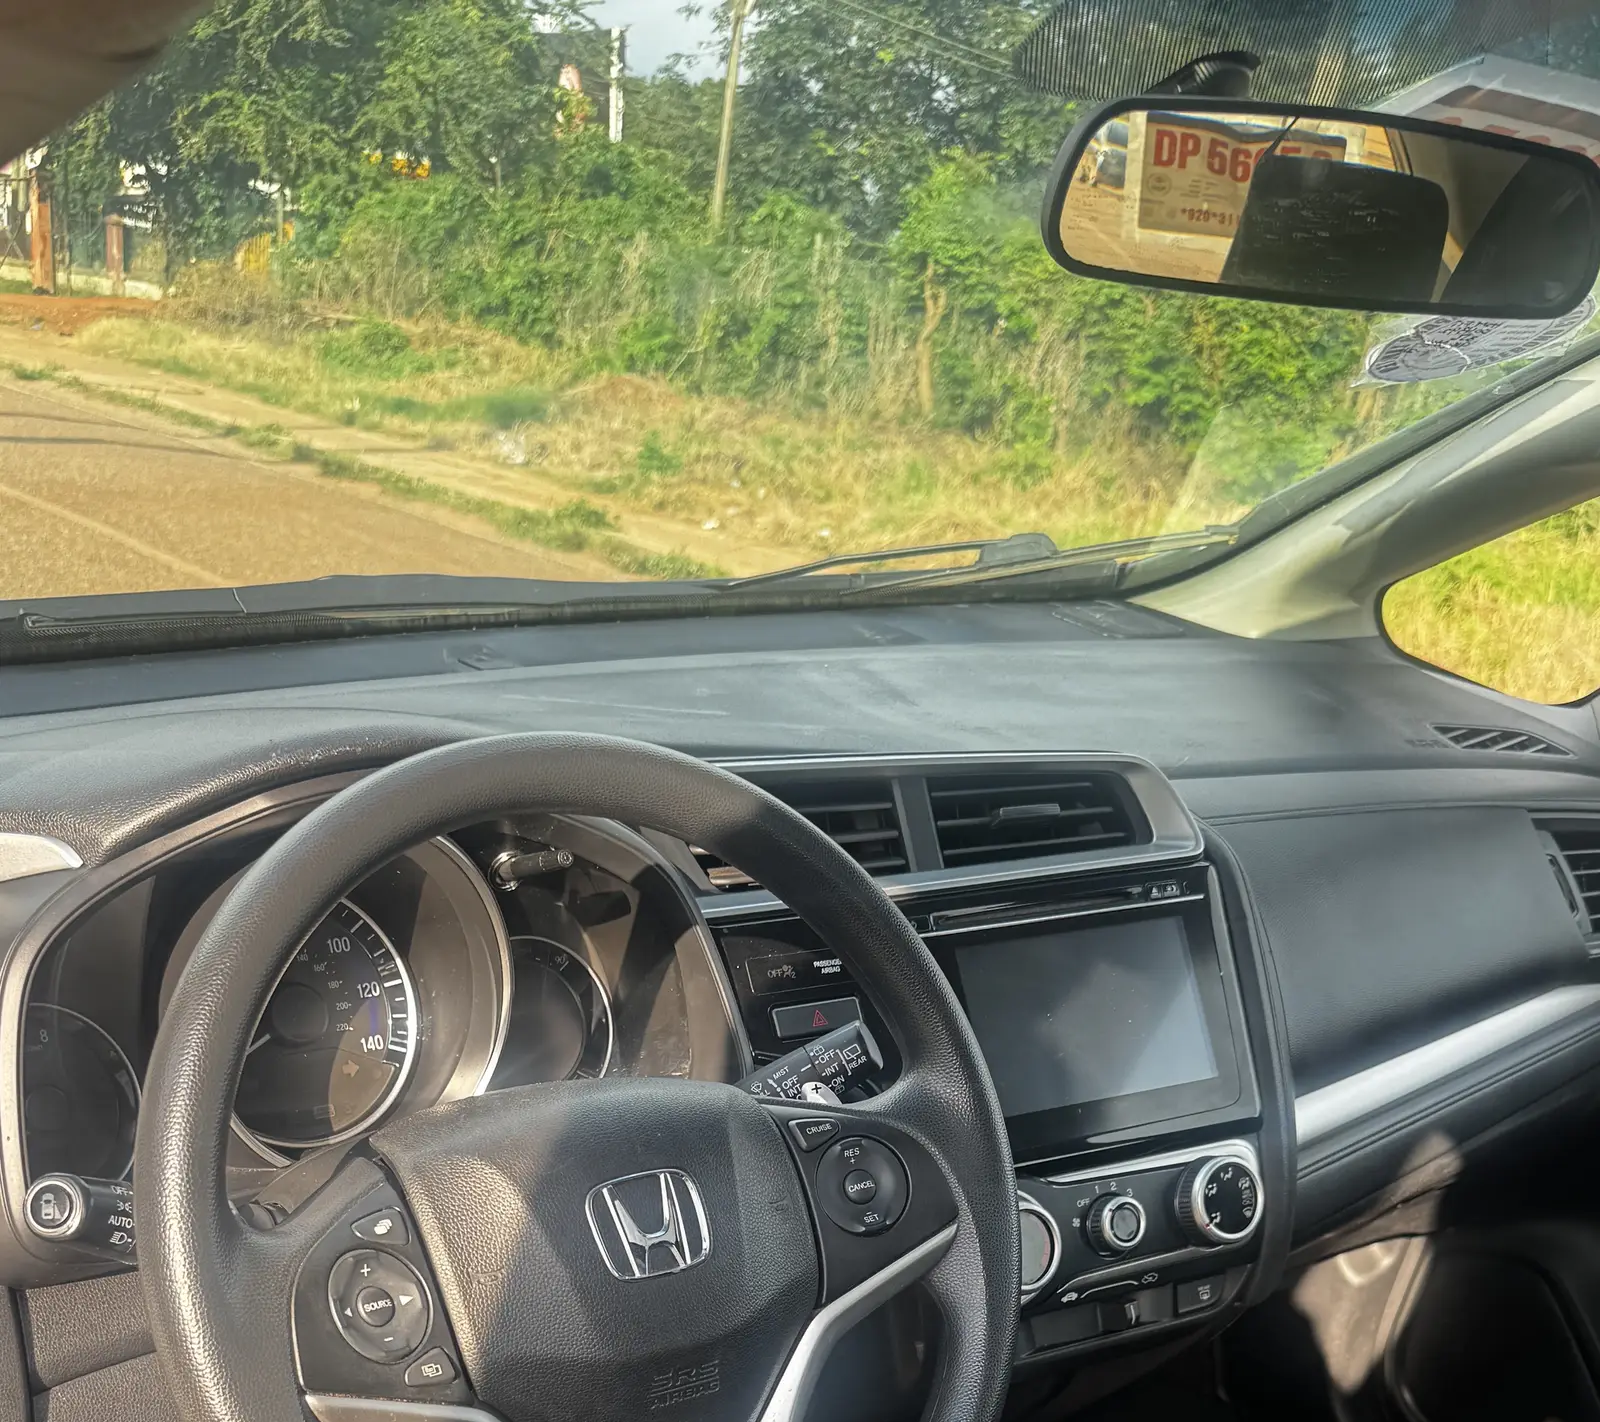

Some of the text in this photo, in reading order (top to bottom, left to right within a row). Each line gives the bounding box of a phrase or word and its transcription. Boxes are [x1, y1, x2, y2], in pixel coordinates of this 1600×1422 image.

[1154, 129, 1201, 169] DP
[326, 936, 351, 953] 100
[297, 953, 309, 962] 140
[313, 963, 325, 972] 160
[767, 968, 783, 979] OFF
[327, 979, 339, 989] 180
[357, 981, 381, 999] 120
[336, 1002, 349, 1011] 200
[336, 1022, 349, 1032] 220
[40, 1029, 48, 1043] 8
[360, 1034, 384, 1053] 140
[818, 1049, 836, 1064] OFF
[848, 1055, 867, 1070] REAR
[772, 1065, 789, 1080] MIST
[825, 1062, 840, 1077] INT
[781, 1074, 798, 1090] OFF
[831, 1074, 845, 1087] ON
[787, 1083, 801, 1097] INT
[806, 1123, 832, 1135] CRUISE
[844, 1147, 860, 1158] RES
[111, 1185, 128, 1196] OFF
[848, 1180, 875, 1193] CANCEL
[1094, 1185, 1100, 1194] 1
[1110, 1182, 1117, 1191] 2
[1126, 1188, 1134, 1198] 3
[1077, 1197, 1090, 1208] OFF
[108, 1215, 133, 1229] AUTO
[863, 1213, 879, 1223] SET
[364, 1299, 393, 1313] SOURCE
[651, 1360, 719, 1393] SRS
[648, 1380, 720, 1410] AIRBAG
